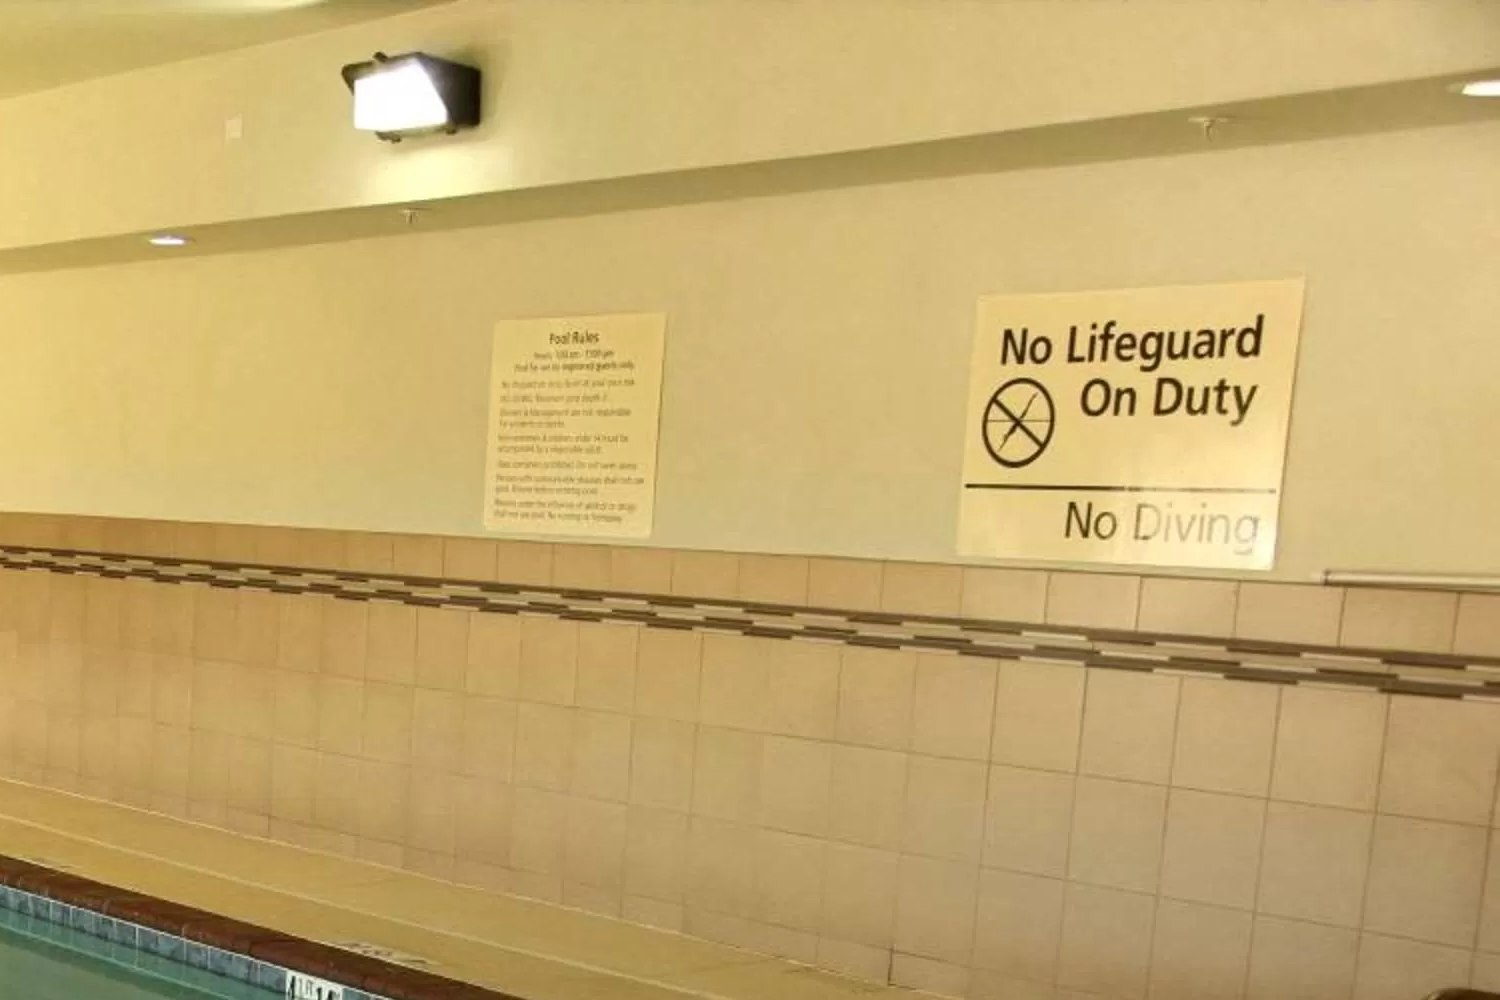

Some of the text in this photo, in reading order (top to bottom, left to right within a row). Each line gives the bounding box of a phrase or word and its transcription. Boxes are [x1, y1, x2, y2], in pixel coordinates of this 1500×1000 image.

[549, 328, 600, 345] Pool Rules
[1000, 314, 1265, 372] No Lifeguard
[1080, 377, 1258, 426] On Duty
[1064, 501, 1261, 555] No Diving
